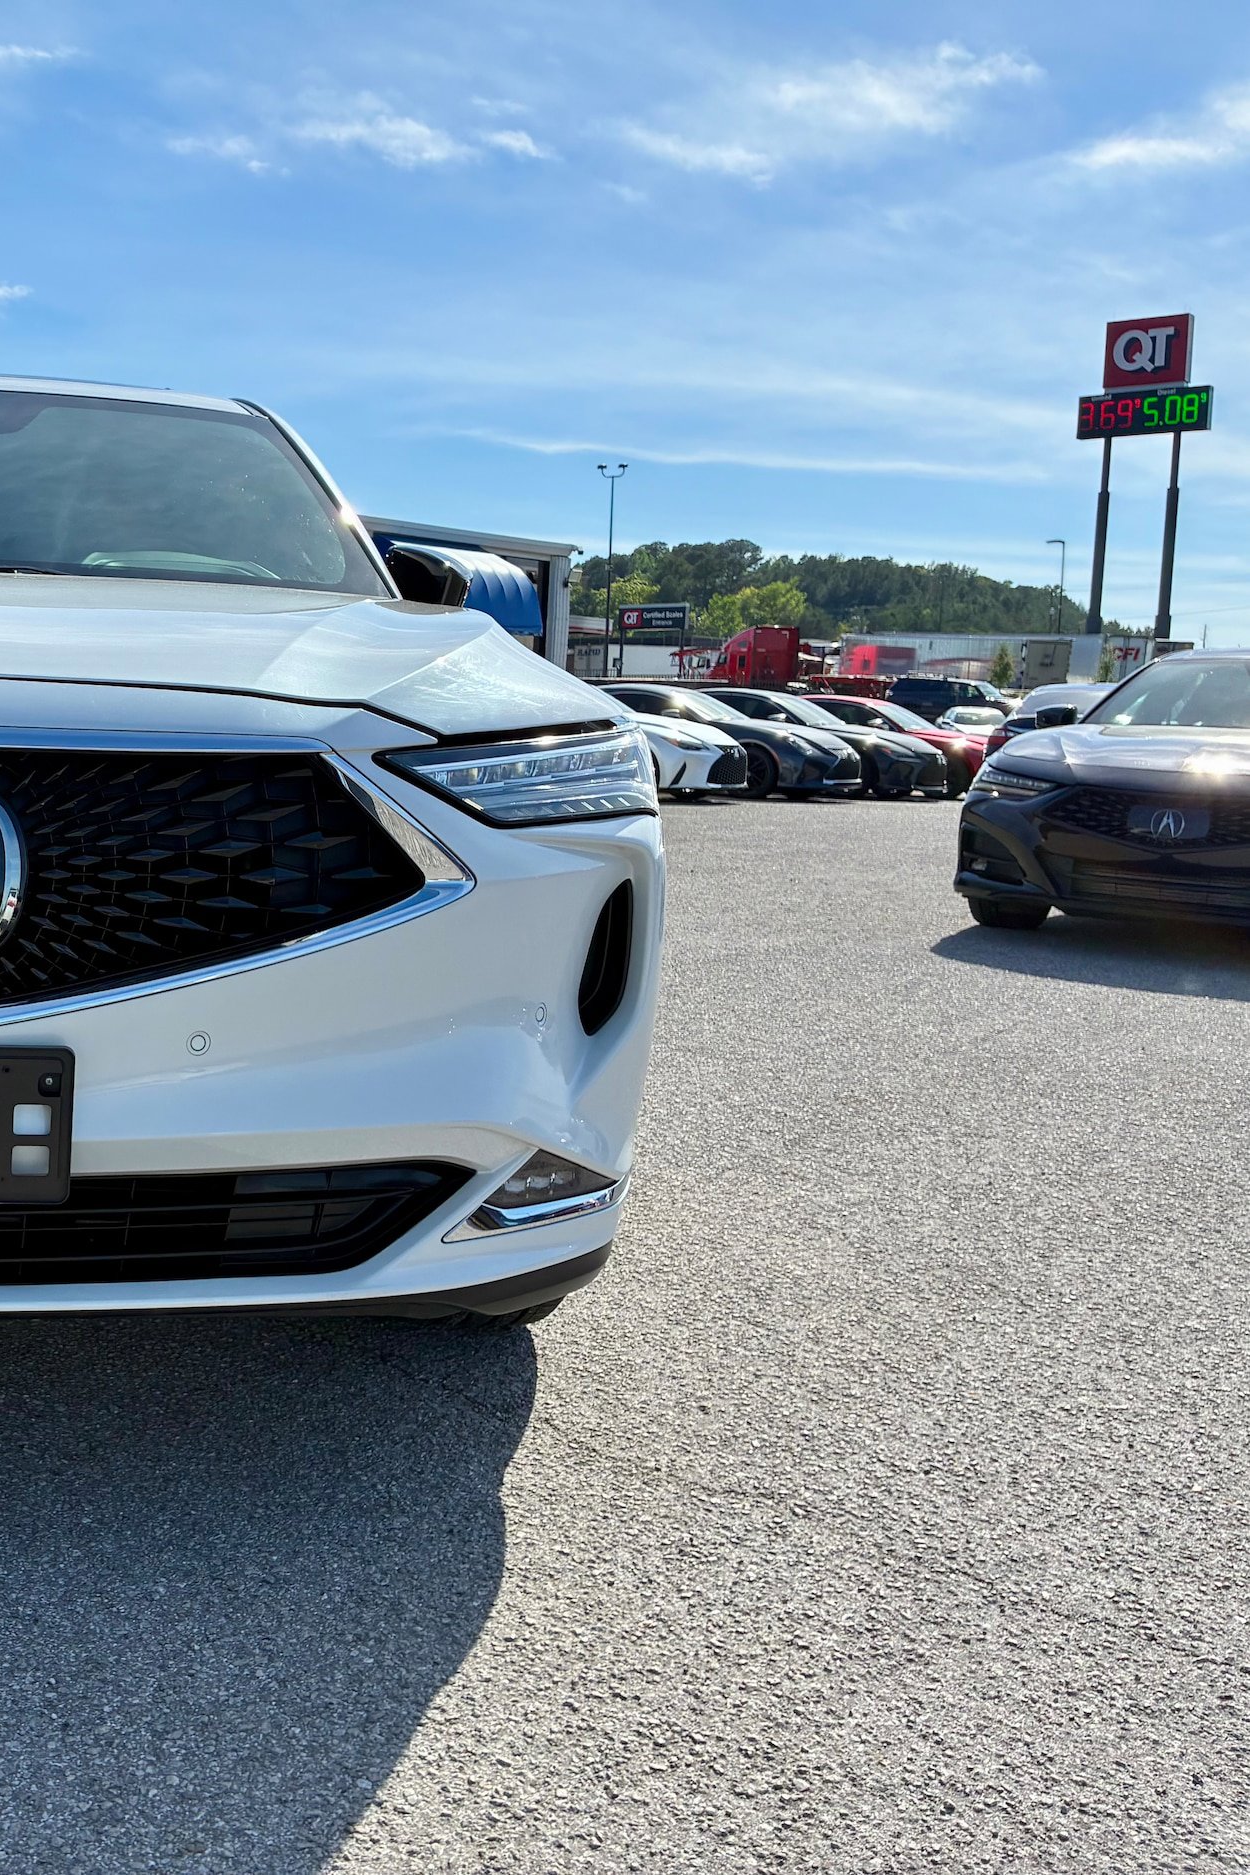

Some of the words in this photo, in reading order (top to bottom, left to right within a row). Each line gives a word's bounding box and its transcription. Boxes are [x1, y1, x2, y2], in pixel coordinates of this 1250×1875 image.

[1113, 326, 1175, 373] QT
[624, 612, 639, 625] QT
[642, 611, 665, 619] Certified
[666, 610, 683, 619] Scales
